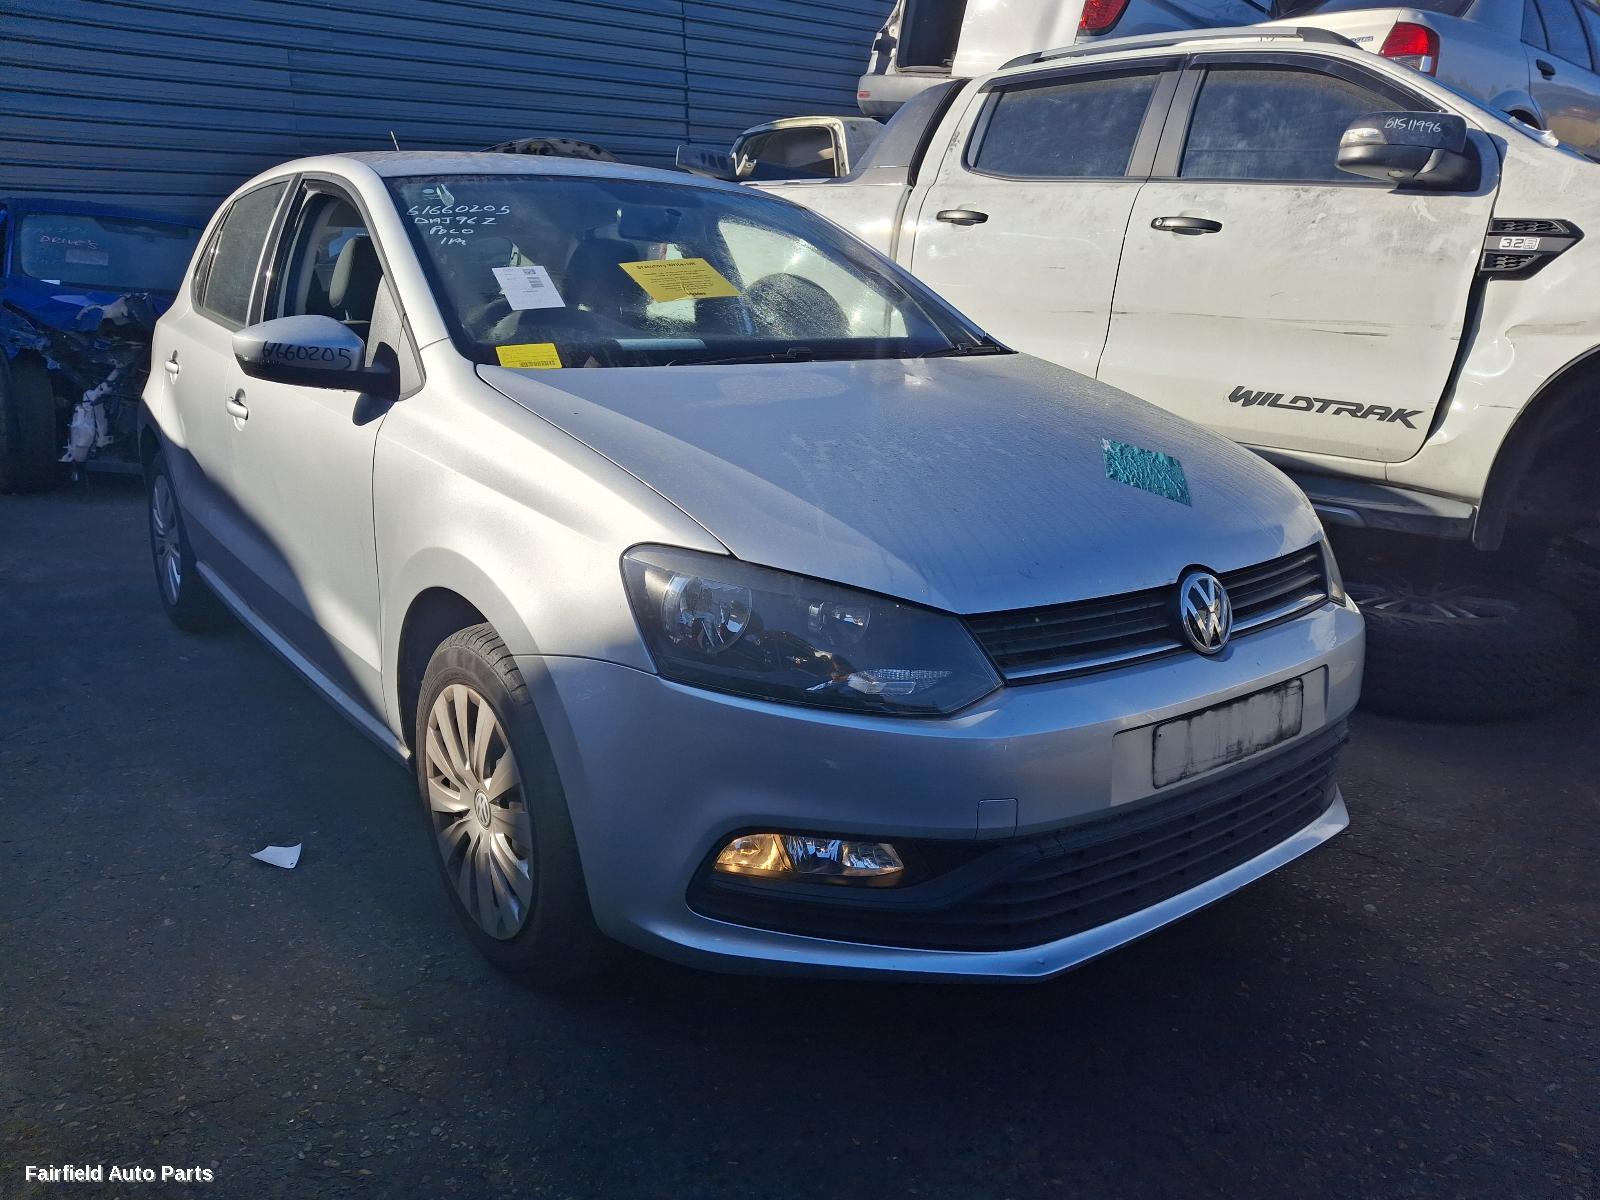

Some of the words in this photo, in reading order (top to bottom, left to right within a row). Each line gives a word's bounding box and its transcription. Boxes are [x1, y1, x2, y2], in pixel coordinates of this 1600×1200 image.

[406, 204, 511, 216] 61660205
[262, 340, 353, 369] 61660205
[1228, 385, 1425, 430] WILDTRAK
[1180, 572, 1233, 654] VW
